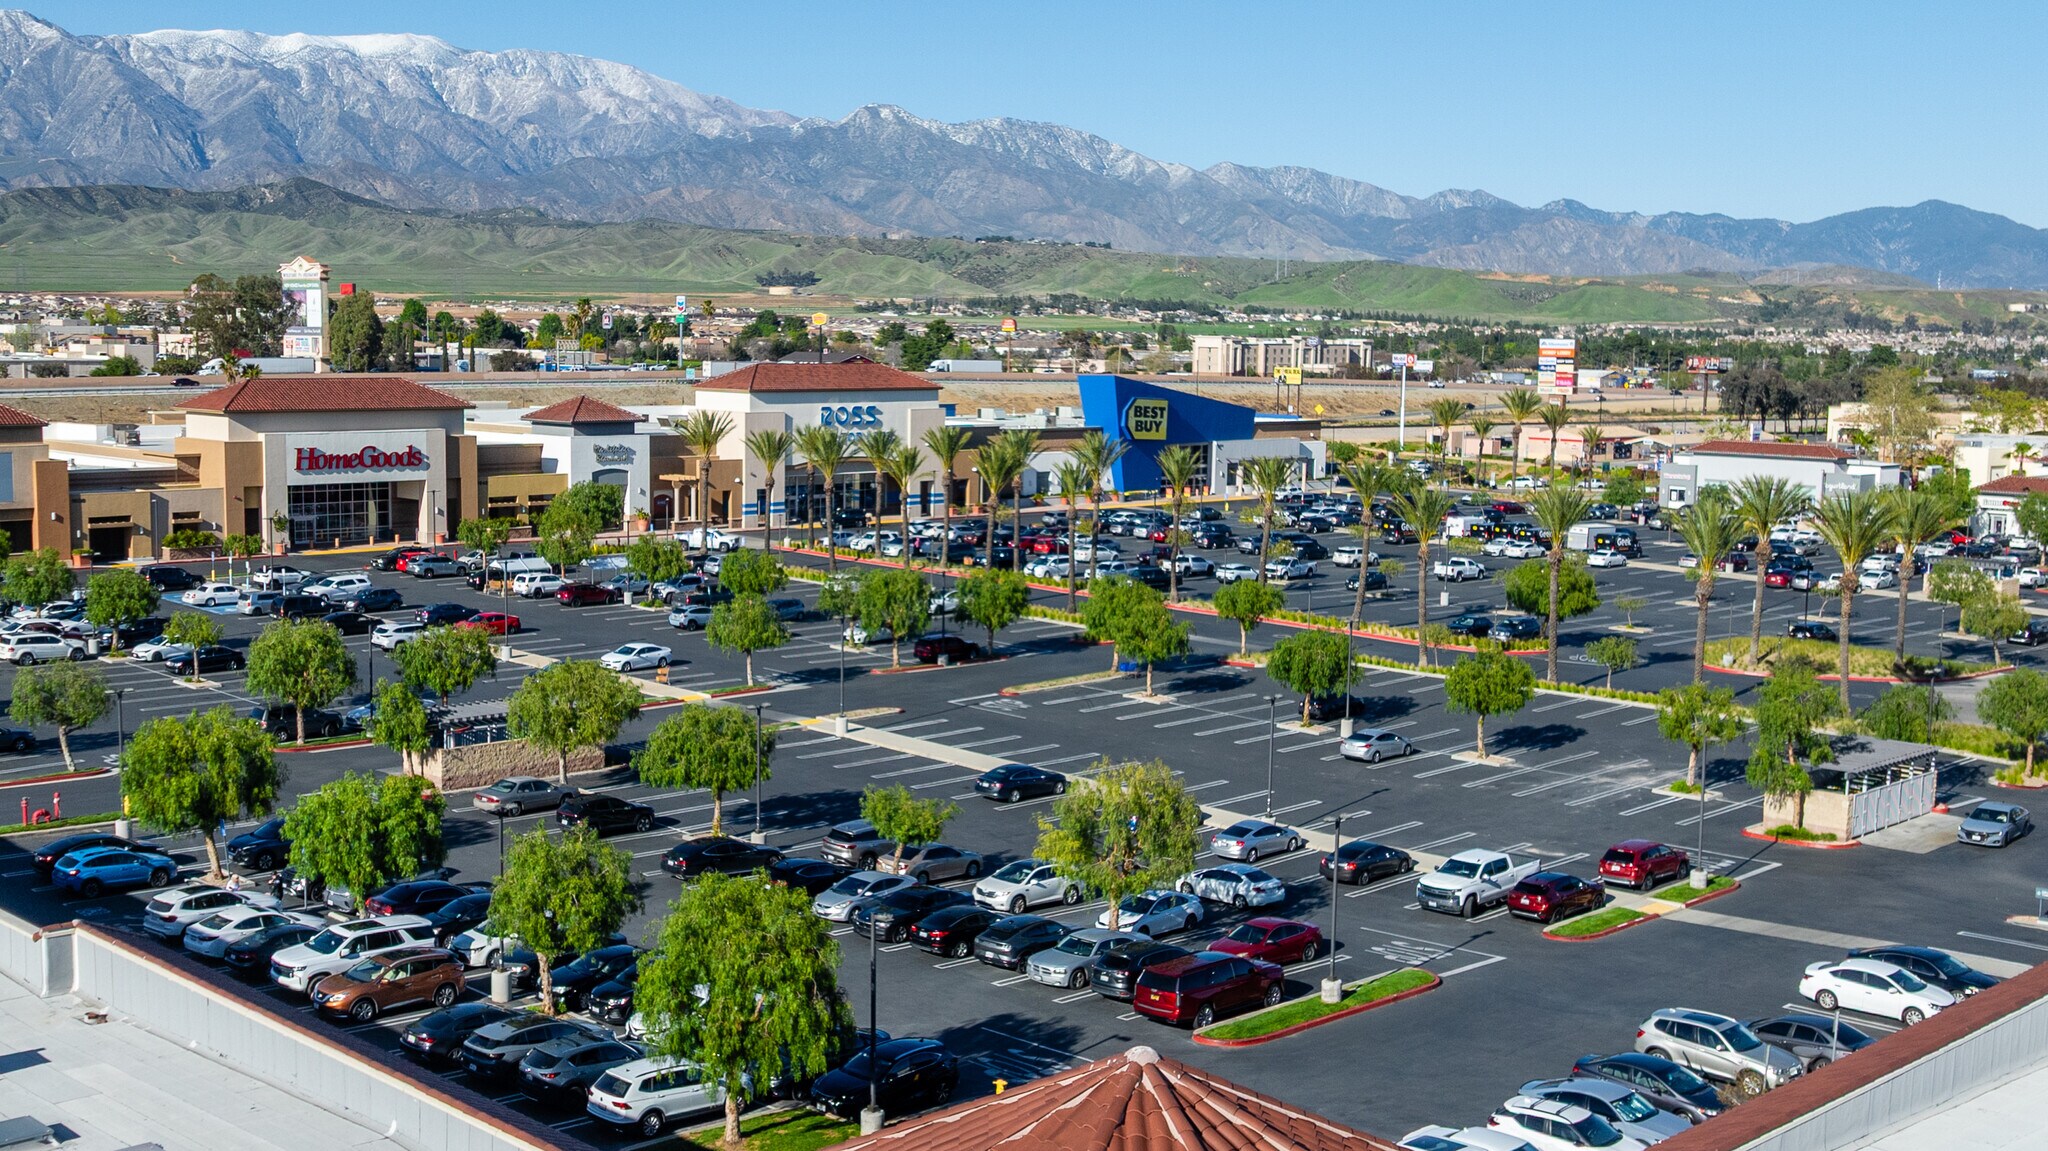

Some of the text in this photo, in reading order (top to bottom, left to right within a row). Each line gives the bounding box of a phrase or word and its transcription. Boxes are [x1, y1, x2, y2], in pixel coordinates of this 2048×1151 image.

[820, 405, 878, 426] ROSS
[1134, 405, 1166, 419] BEST
[1135, 420, 1163, 433] BUY
[294, 445, 422, 471] HomeGoods
[1616, 537, 1631, 546] Geek
